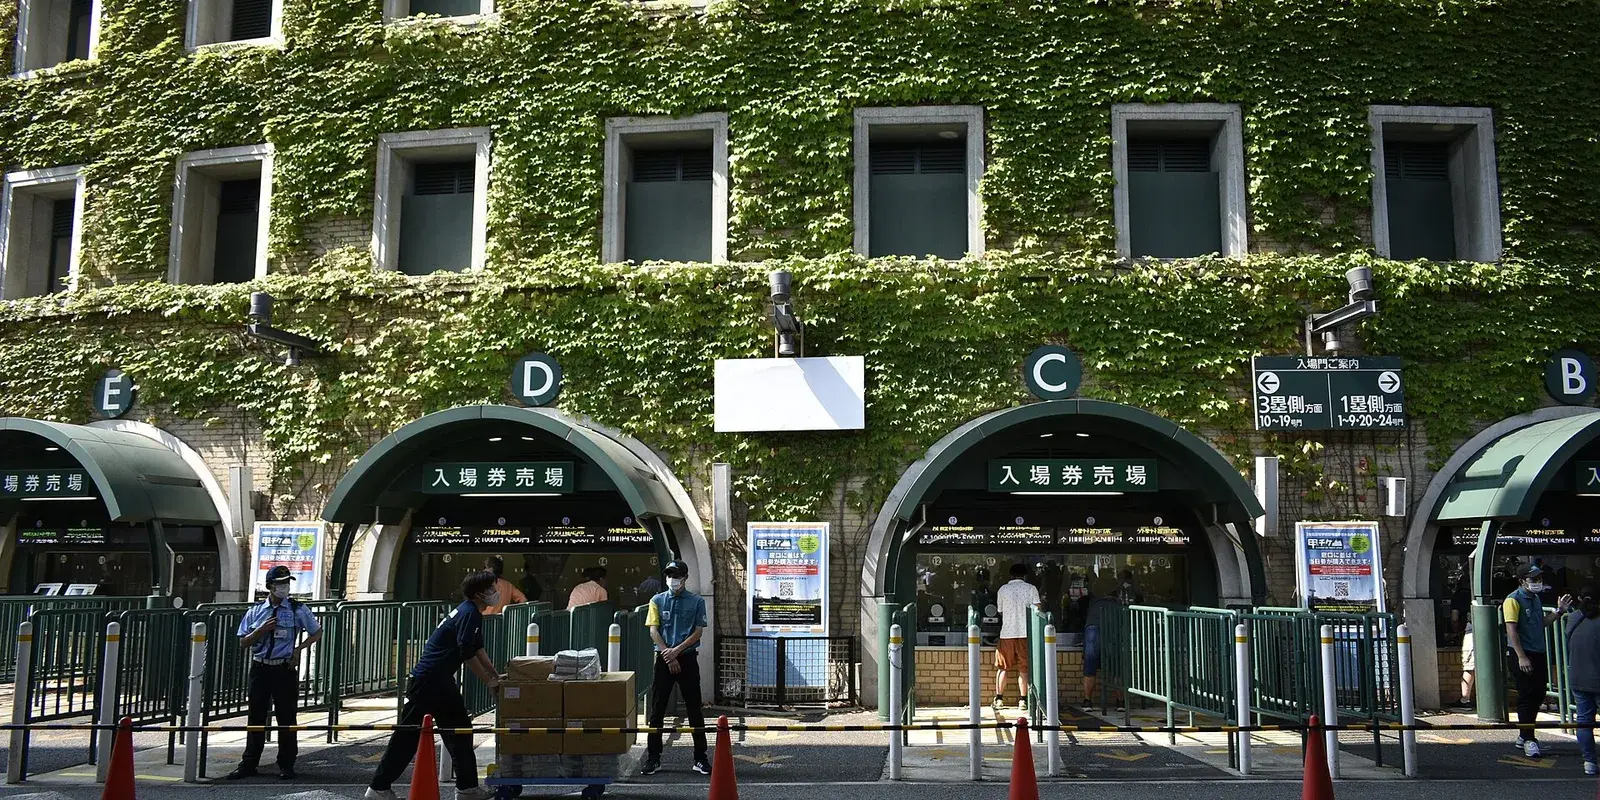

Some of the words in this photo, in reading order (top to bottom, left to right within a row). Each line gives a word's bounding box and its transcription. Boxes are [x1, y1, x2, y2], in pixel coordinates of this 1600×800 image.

[1033, 353, 1067, 392] C
[1297, 358, 1359, 369] 入場門ご案内
[523, 360, 554, 397] D
[1561, 357, 1586, 395] B
[102, 377, 122, 410] E
[1258, 395, 1323, 414] 3塁側方面
[1340, 395, 1403, 414] 1塁側方面
[4, 473, 82, 492] 場券売場
[431, 467, 564, 487] 入場券売場
[1000, 464, 1147, 485] 入場券売場
